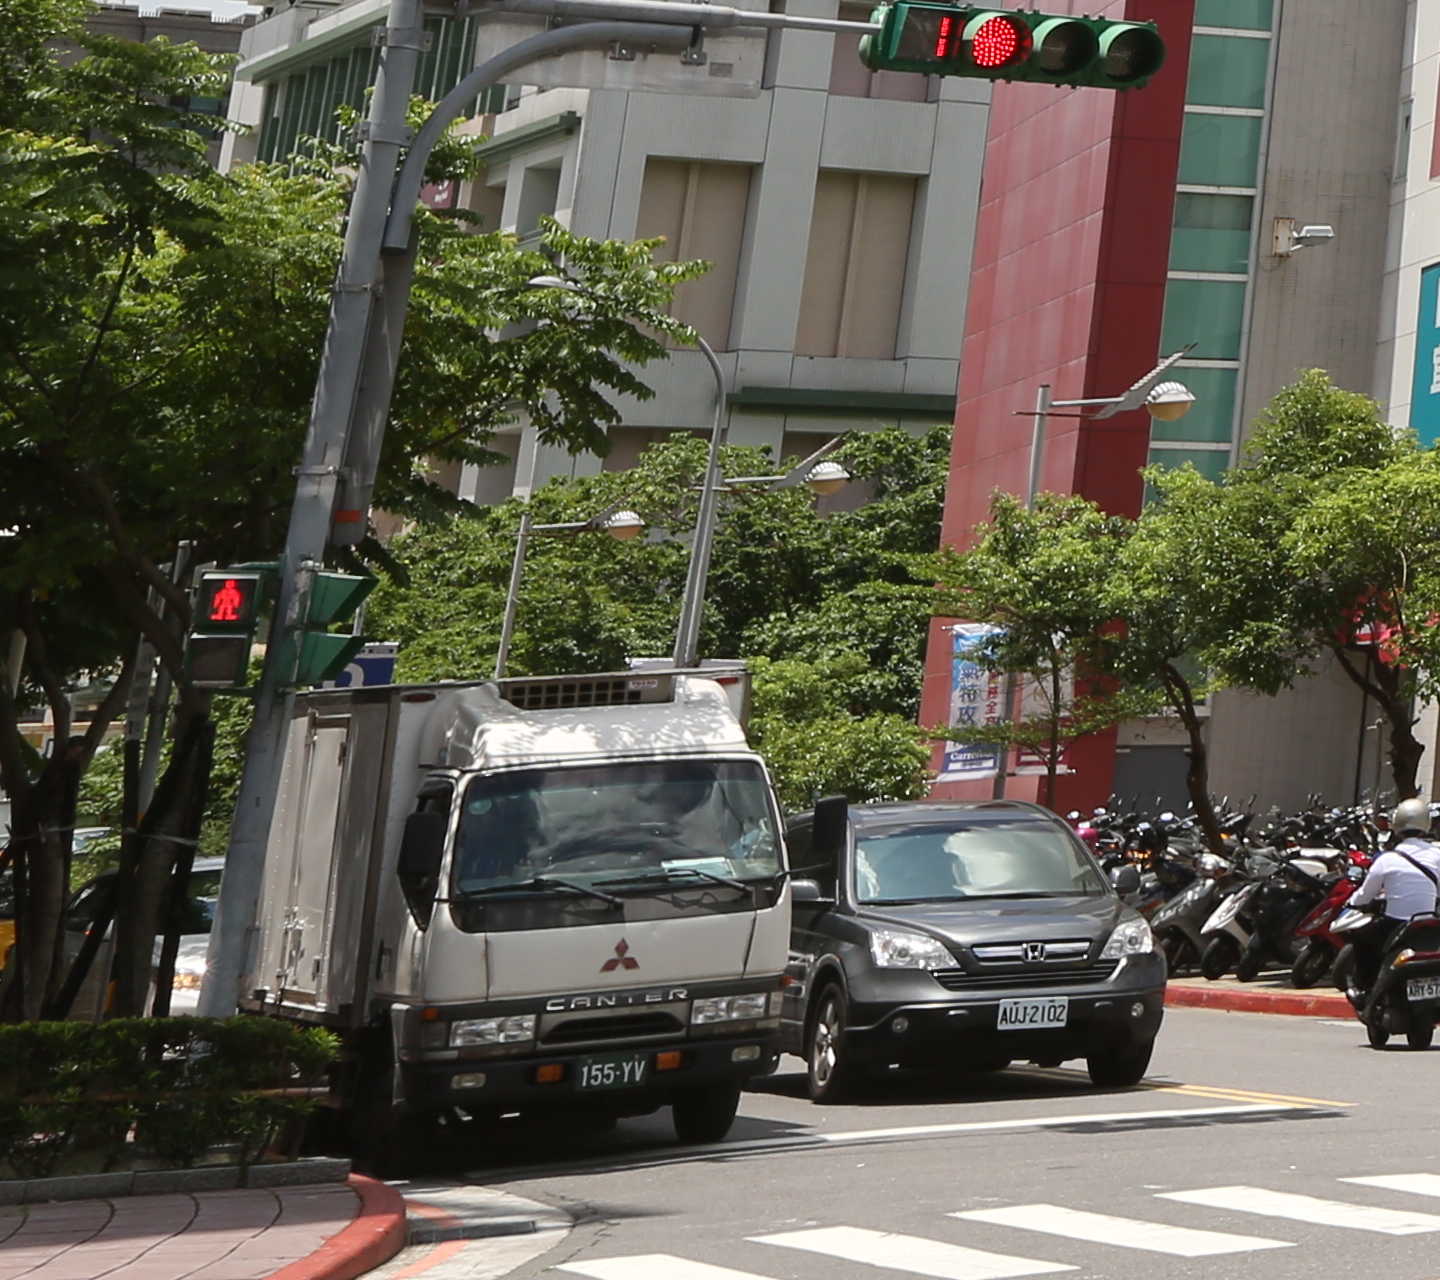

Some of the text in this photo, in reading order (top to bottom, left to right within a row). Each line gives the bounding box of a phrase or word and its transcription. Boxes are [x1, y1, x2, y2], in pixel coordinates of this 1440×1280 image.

[545, 988, 688, 1012] CANTER
[1000, 1005, 1066, 1024] AUJ-2102
[581, 1060, 646, 1086] 155-YV
